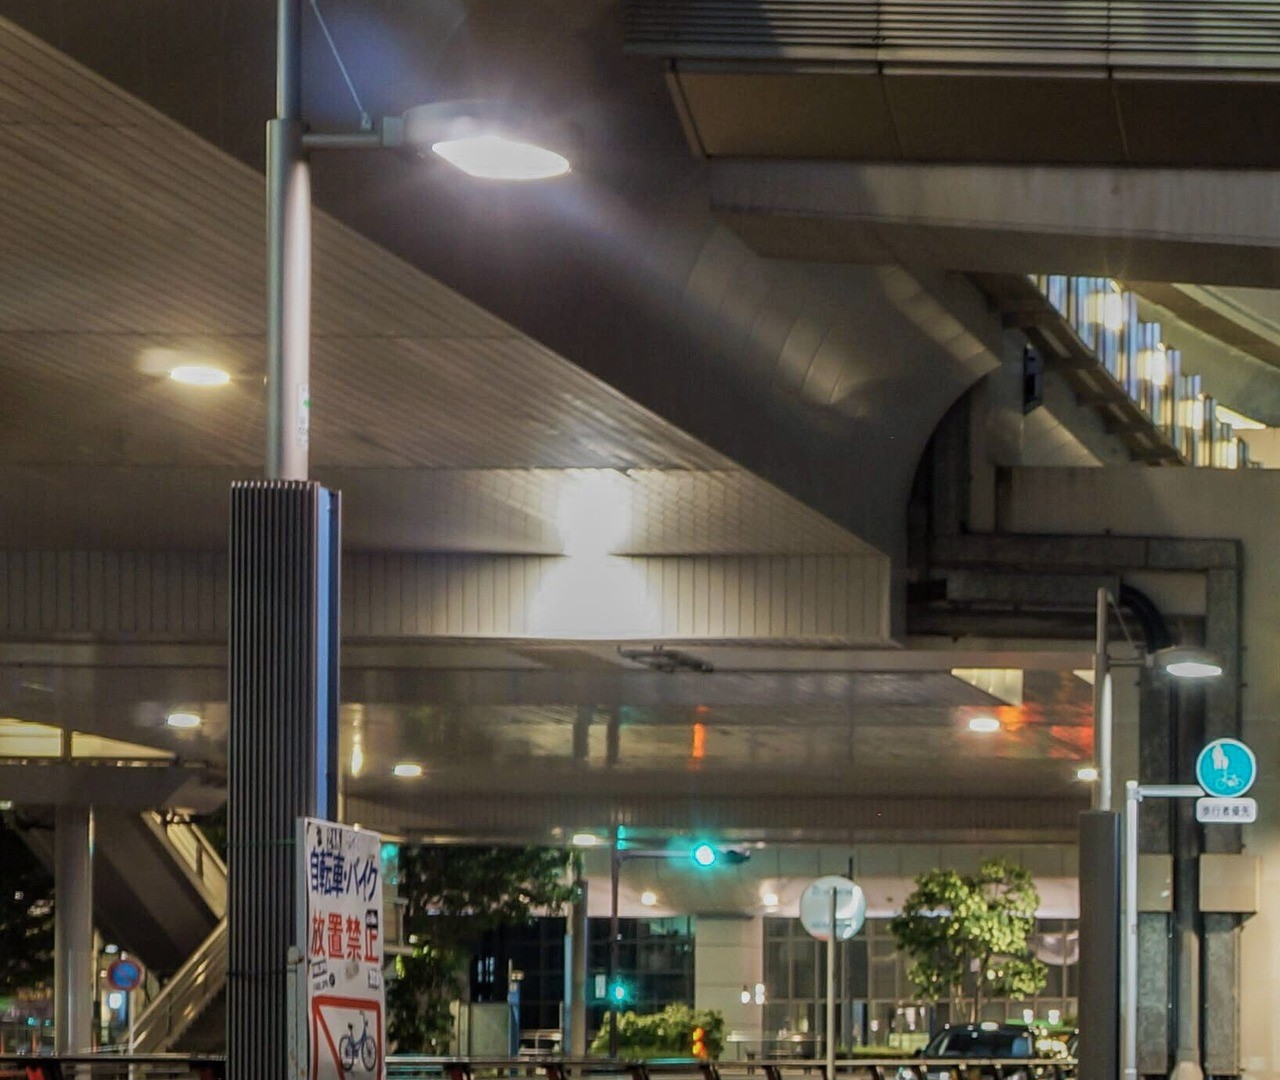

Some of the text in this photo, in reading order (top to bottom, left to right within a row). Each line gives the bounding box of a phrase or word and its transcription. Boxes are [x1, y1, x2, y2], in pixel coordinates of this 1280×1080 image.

[311, 850, 378, 903] 自転車・バイク
[311, 910, 379, 963] 放置禁止
